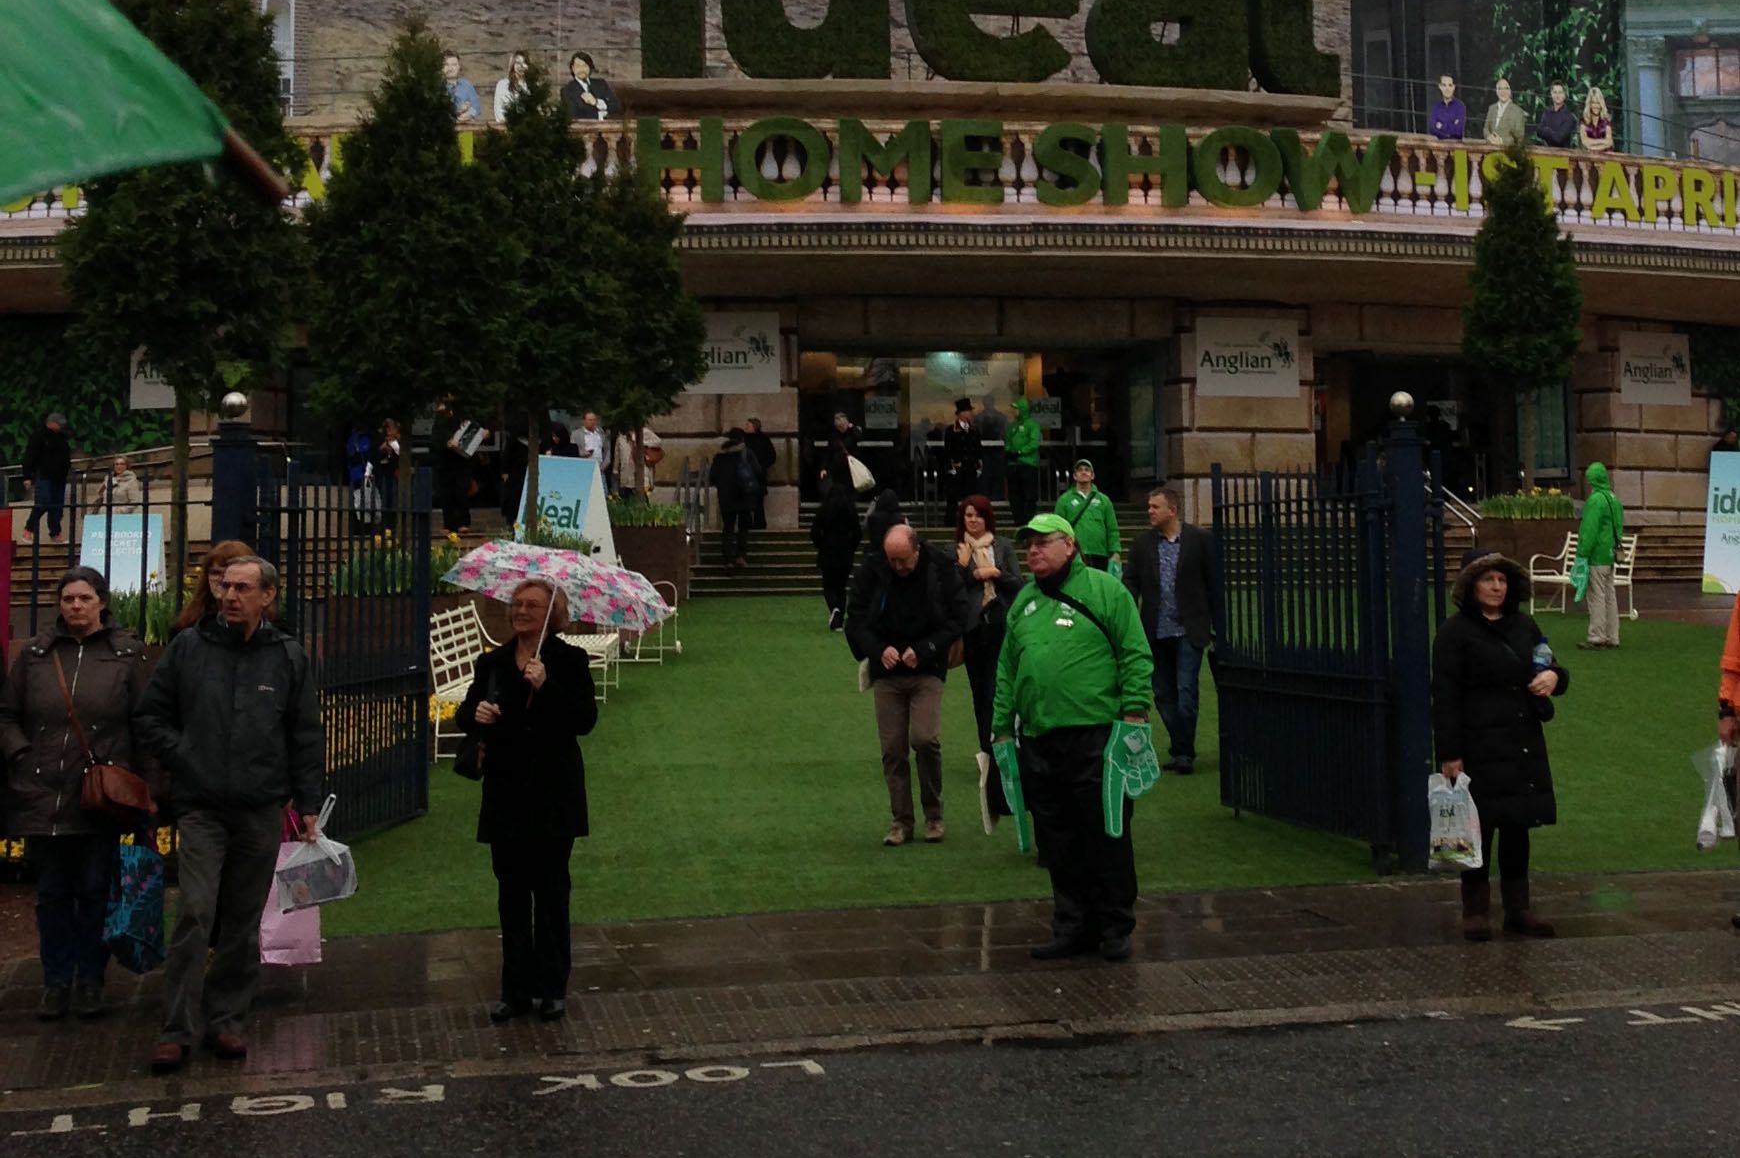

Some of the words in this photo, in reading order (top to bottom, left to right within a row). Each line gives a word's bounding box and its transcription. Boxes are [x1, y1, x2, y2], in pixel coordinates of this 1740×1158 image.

[636, 117, 1004, 205] HOME
[1034, 122, 1398, 215] SHOW
[1200, 350, 1272, 374] Anglian
[1623, 361, 1673, 384] Anglian
[1712, 487, 1740, 514] id
[532, 1059, 827, 1094] LOOK
[10, 1083, 447, 1138] RIGHT
